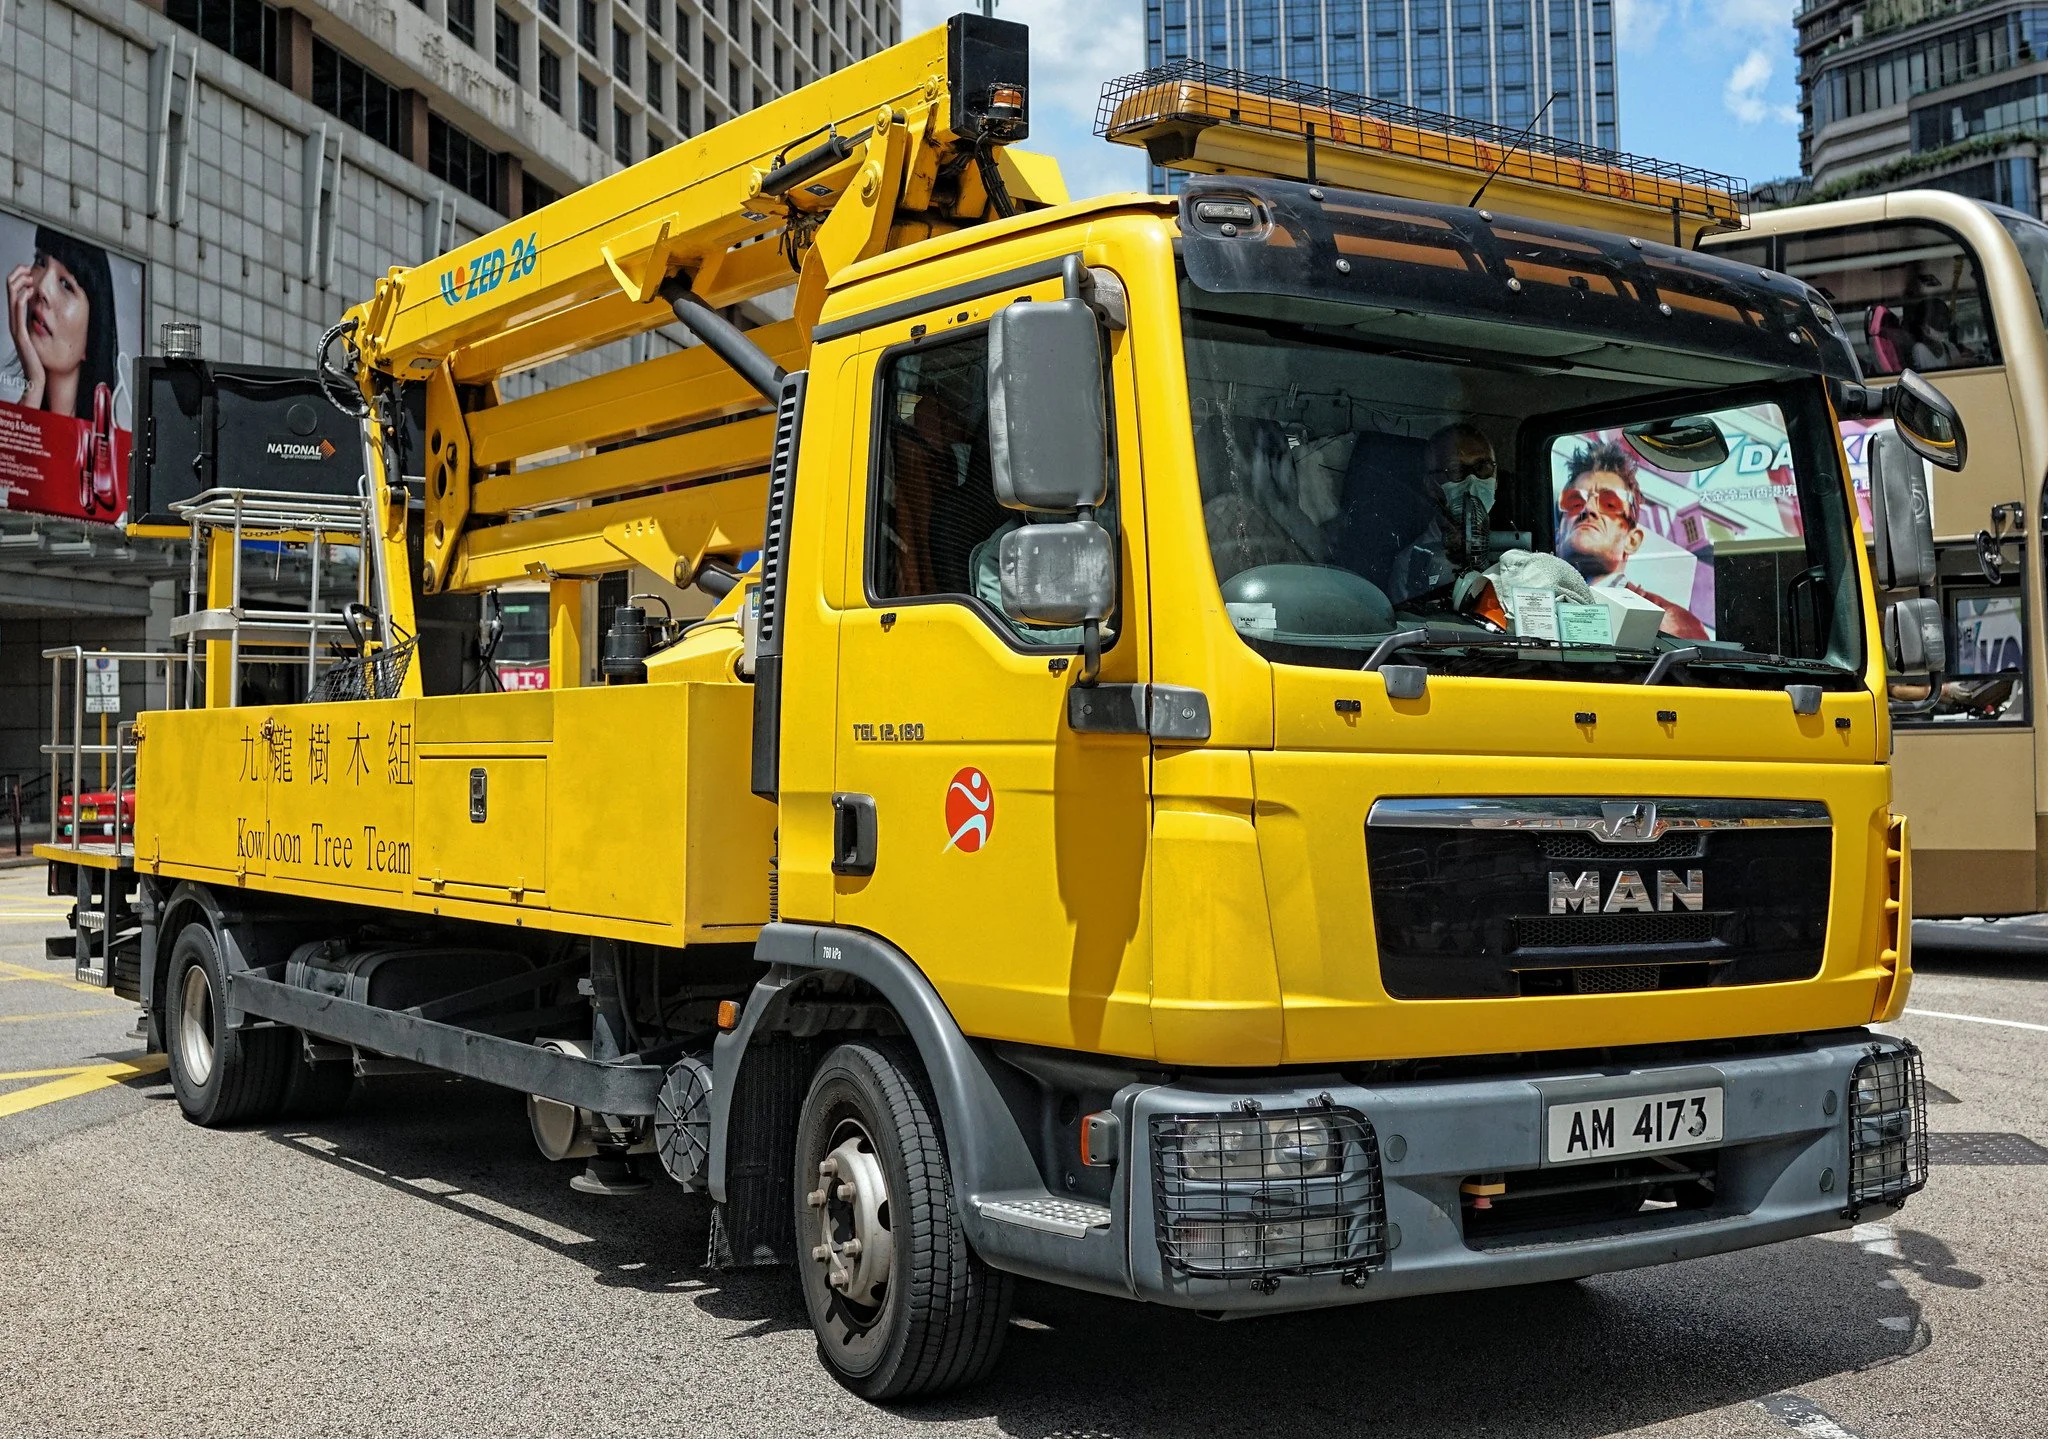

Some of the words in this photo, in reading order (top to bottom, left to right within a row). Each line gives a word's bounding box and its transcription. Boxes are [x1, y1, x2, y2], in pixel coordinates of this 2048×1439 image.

[465, 248, 505, 301] ZED
[508, 232, 537, 282] 26
[267, 443, 322, 455] NATIONAL
[239, 720, 413, 786] 九龍樹木組
[853, 723, 878, 741] TGL
[237, 817, 302, 864] Kowloon
[311, 823, 353, 869] Tree
[364, 825, 412, 875] Team
[1548, 870, 1704, 914] MAN
[1567, 1107, 1615, 1153] AM
[1632, 1097, 1707, 1143] 4173
